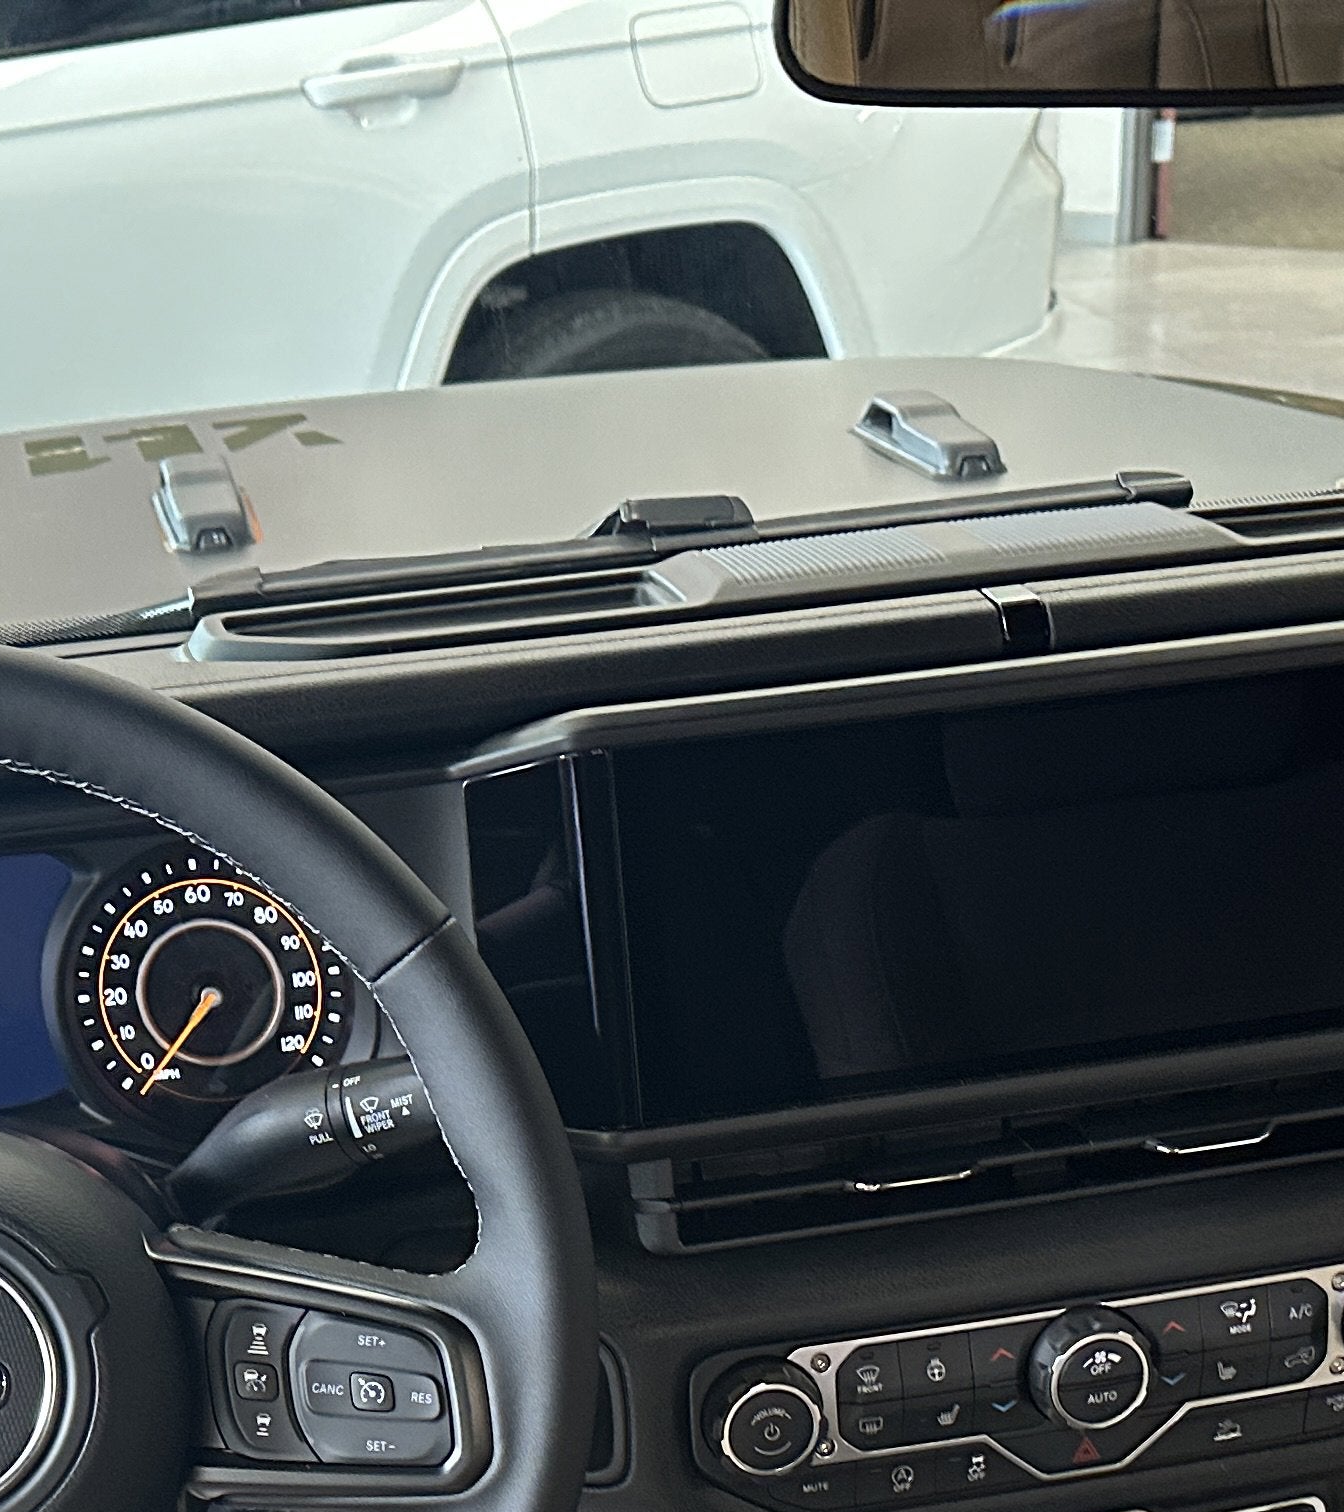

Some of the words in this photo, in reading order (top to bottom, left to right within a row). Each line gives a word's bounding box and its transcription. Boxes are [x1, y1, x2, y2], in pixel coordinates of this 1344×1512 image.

[184, 885, 211, 903] 60
[224, 892, 244, 907] 70
[153, 899, 174, 915] 50
[254, 906, 278, 924] 80
[123, 920, 148, 938] 40
[280, 935, 301, 950] 90
[110, 954, 130, 970] 30
[292, 971, 316, 987] 100
[104, 987, 128, 1007] 20
[294, 1005, 314, 1020] 110
[119, 1025, 136, 1040] 10
[280, 1035, 305, 1052] 120
[140, 1052, 155, 1070] 0
[342, 1075, 362, 1088] OFF
[390, 1094, 414, 1109] MIST
[360, 1110, 391, 1126] FRONT
[363, 1118, 395, 1135] WIPER
[308, 1131, 335, 1146] PULL
[1288, 1302, 1314, 1322] A/C
[1228, 1323, 1253, 1336] MODE
[357, 1333, 387, 1349] SET+
[1089, 1363, 1113, 1377] OFF
[311, 1382, 345, 1396] CANC
[410, 1391, 433, 1405] RES
[1087, 1389, 1118, 1406] AUTO
[802, 1480, 830, 1494] MUTE
